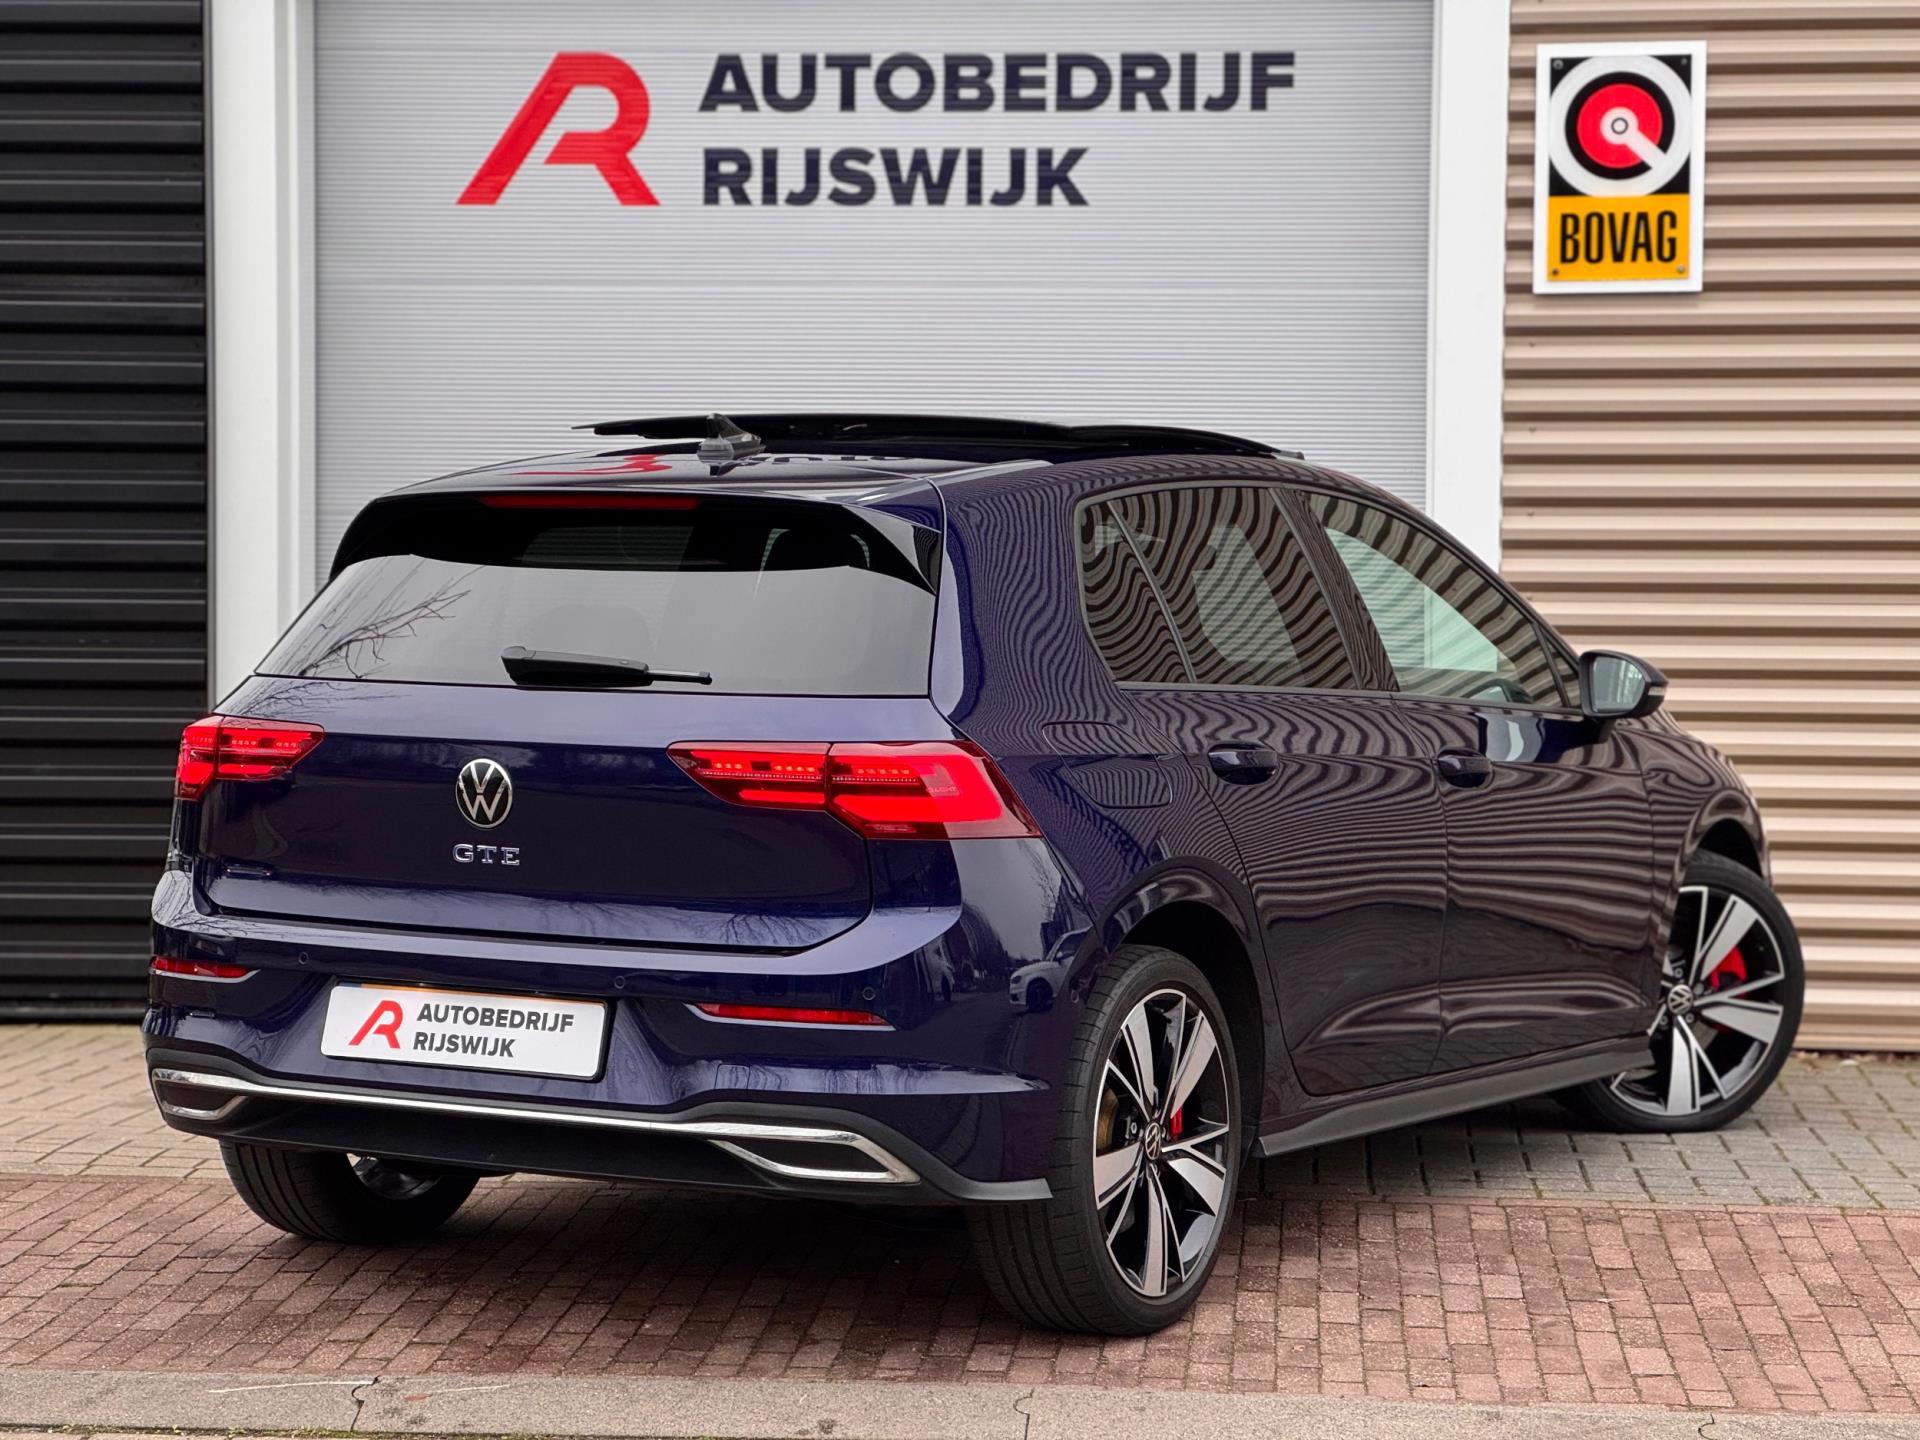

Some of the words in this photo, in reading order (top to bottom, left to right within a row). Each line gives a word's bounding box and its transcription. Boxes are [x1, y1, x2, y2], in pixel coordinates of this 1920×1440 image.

[698, 51, 1296, 113] AUTOBEDRIJF
[702, 147, 1090, 207] RIJSWIJK
[1559, 210, 1678, 265] BOVAG
[453, 843, 520, 866] GTE
[416, 1002, 575, 1034] AUTOBEDRIJF
[413, 1031, 517, 1059] RIJSWIJK
